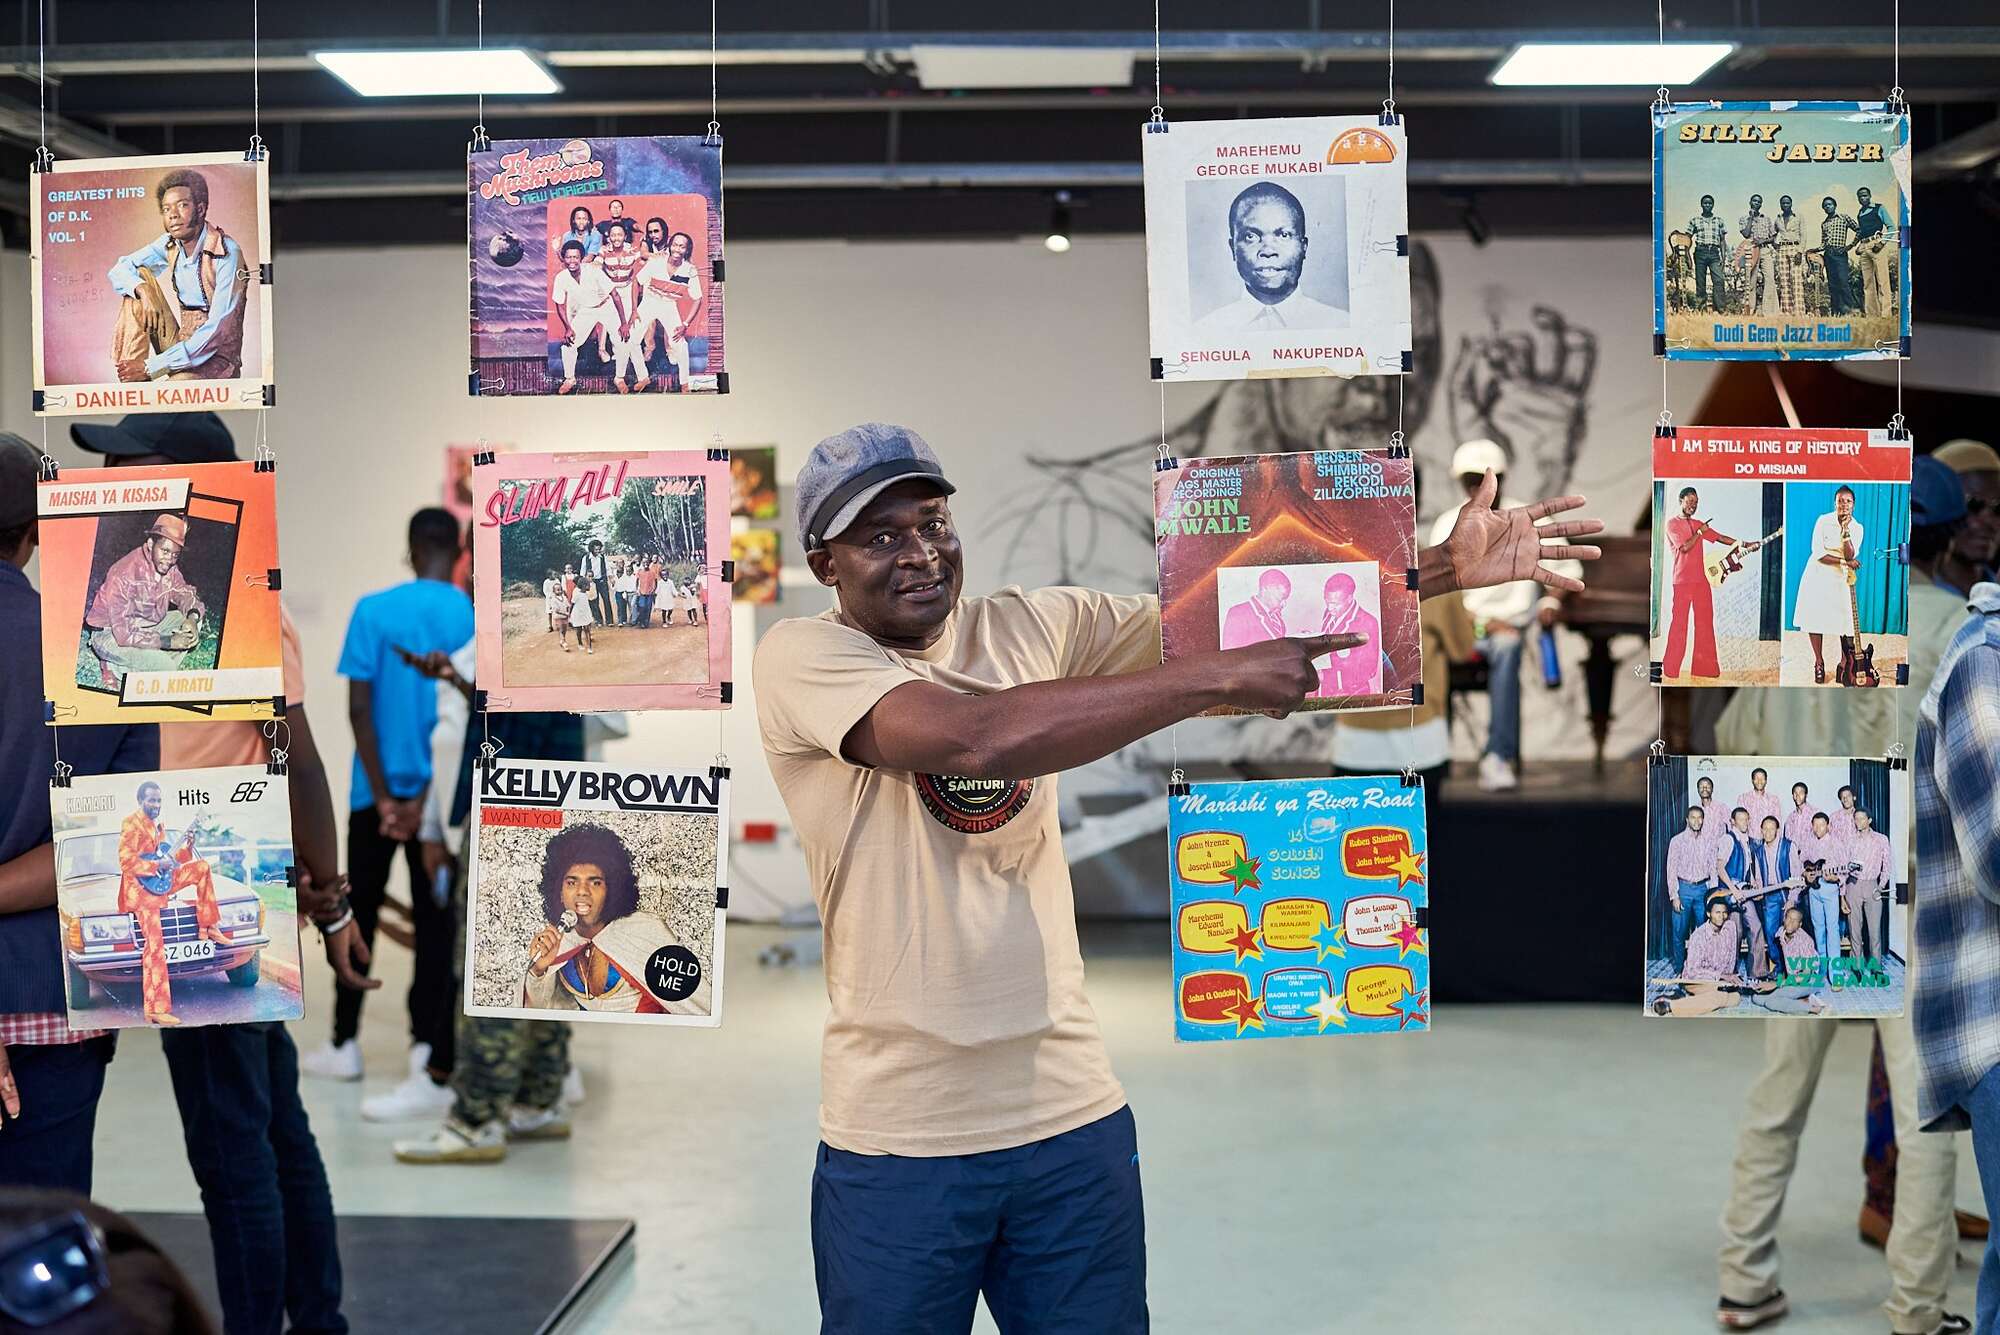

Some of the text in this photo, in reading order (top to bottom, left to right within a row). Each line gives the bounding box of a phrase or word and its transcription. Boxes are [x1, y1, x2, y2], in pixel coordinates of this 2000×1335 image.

[1680, 124, 1782, 142] SILLY
[1216, 145, 1301, 158] MAREHEMU
[1766, 144, 1884, 162] JABER
[500, 148, 562, 174] Them
[1197, 162, 1323, 177] GEORGE MUKABI
[480, 160, 603, 206] Mushrooms
[48, 187, 145, 203] GREATEST HITS
[48, 211, 92, 223] OF D.K.
[48, 231, 86, 243] VOL. 1
[1714, 324, 1850, 342] Dudi Gem Jazz Band
[1181, 347, 1364, 363] SENGULA NAKUPENDA
[76, 387, 230, 408] DANIEL KAMAU
[1672, 440, 1862, 455] I AM STILL KING OF HISTORY
[1314, 451, 1363, 465] REUBEN
[1190, 468, 1241, 478] ORIGINAL
[1317, 463, 1382, 477] SHIMBIRO
[1735, 463, 1807, 475] DO MISIANI
[1177, 478, 1242, 489] AGS MASTER
[1334, 476, 1384, 488] REKODI
[49, 486, 168, 507] MAISHA YA KISASA
[480, 460, 629, 528] SLIM ALI
[1174, 487, 1242, 499] RECORDINGS
[1314, 485, 1413, 501] ZILIZOPENDWA
[1169, 500, 1239, 517] JOHN
[1158, 515, 1251, 536] MWALE
[167, 677, 213, 694] KIRATU
[230, 781, 268, 803] 86
[481, 768, 719, 806] KELLY BROWN
[948, 780, 1005, 792] SANTURI
[66, 795, 116, 814] KAMARU
[179, 790, 210, 806] Hits
[1178, 787, 1416, 817] Marashi ya River Road
[491, 811, 529, 823] WANT
[534, 813, 562, 825] YOU
[1187, 842, 1204, 850] John
[1371, 833, 1403, 845] Shimbiro
[1267, 847, 1323, 862] GOLDEN
[1188, 862, 1211, 872] Joseph
[1355, 858, 1373, 868] John
[1271, 865, 1321, 880] SONGS
[1188, 913, 1224, 923] Marehemu
[1354, 907, 1371, 915] John
[1198, 920, 1224, 930] Edward
[1356, 926, 1382, 936] Thomas
[184, 943, 210, 958] 046
[655, 955, 699, 977] HOLD
[1786, 956, 1881, 971] VICTORIA
[659, 975, 683, 992] ME
[1357, 979, 1387, 993] George
[1775, 973, 1891, 988] JAZZ BAND
[1187, 994, 1205, 1004] John
[1366, 987, 1397, 1001] Mukabi
